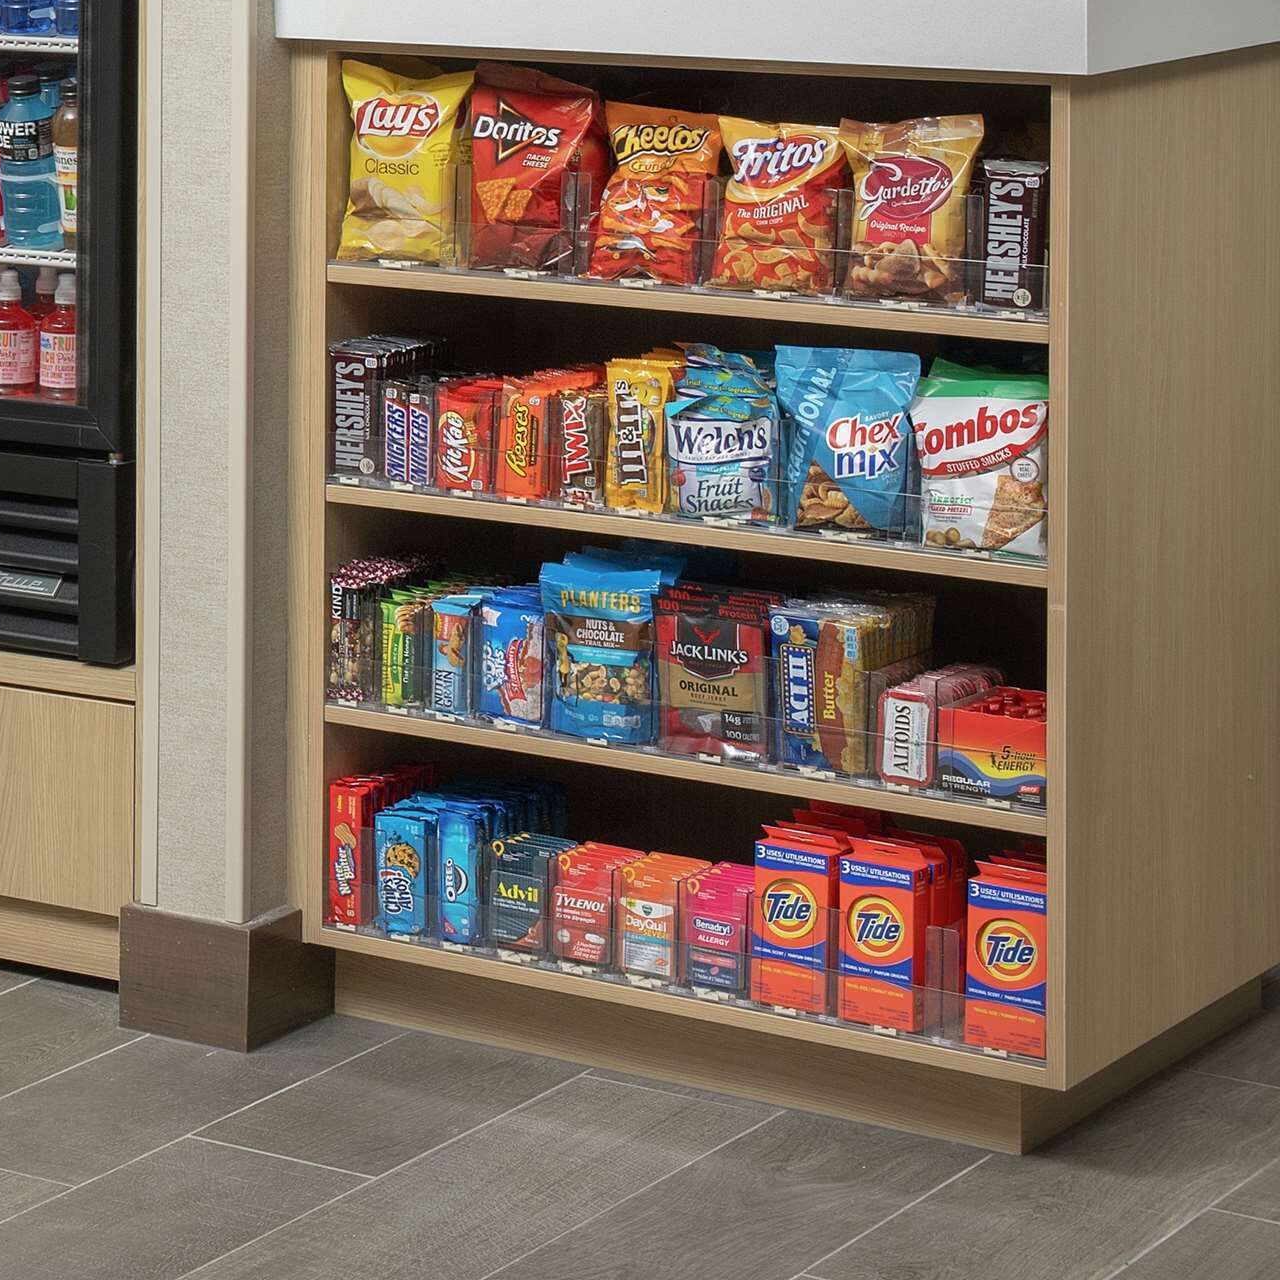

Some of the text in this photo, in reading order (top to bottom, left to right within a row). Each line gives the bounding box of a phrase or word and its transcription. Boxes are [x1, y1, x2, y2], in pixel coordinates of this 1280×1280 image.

[357, 95, 441, 137] Lay's
[473, 115, 562, 148] Doritos
[611, 124, 710, 158] Cheetos
[364, 158, 420, 176] Classic
[522, 160, 550, 169] CHEESE
[733, 137, 827, 182] Fritos
[859, 161, 950, 221] Gardetto's
[752, 195, 810, 219] ORIGINAL
[870, 220, 927, 233] Original Recipe
[984, 181, 1025, 300] HERSHEY'S
[335, 361, 365, 468] HERSHEY'S
[385, 400, 407, 483] SNICKERS
[563, 395, 592, 485] TWIX
[671, 423, 768, 455] Welch's
[827, 415, 901, 450] Chex
[409, 405, 430, 487] SNICKERS
[946, 448, 1012, 473] STUFFED SNACKS
[696, 478, 743, 499] Fruit
[686, 495, 755, 514] Snacks
[330, 583, 343, 620] KIND
[560, 589, 641, 614] PLANTERS
[576, 627, 625, 643] CHOCOLATE
[586, 619, 615, 632] NUTS &
[670, 640, 704, 661] JACK
[679, 680, 739, 697] ORIGINAL
[822, 671, 836, 720] Butter
[790, 686, 811, 727] ACT
[892, 703, 912, 774] ALTOIDS
[996, 760, 1037, 771] ENERGY
[941, 781, 992, 793] STRENGTH
[942, 774, 992, 788] REGULAR
[757, 845, 766, 858] 3
[785, 852, 826, 866] UTILISATIONS
[445, 858, 457, 903] OREO
[841, 860, 850, 873] 3
[869, 868, 911, 882] UTILISATIONS
[496, 881, 539, 903] Advil
[555, 893, 607, 914] TYLENOL
[970, 883, 980, 897] 3
[1000, 891, 1044, 905] UTILISATIONS
[766, 891, 811, 924] Tide
[625, 914, 667, 933] DayQuil
[694, 918, 732, 935] Benadryl
[855, 911, 901, 945] Tide
[697, 934, 730, 947] ALLERGY
[986, 934, 1035, 967] Tide
